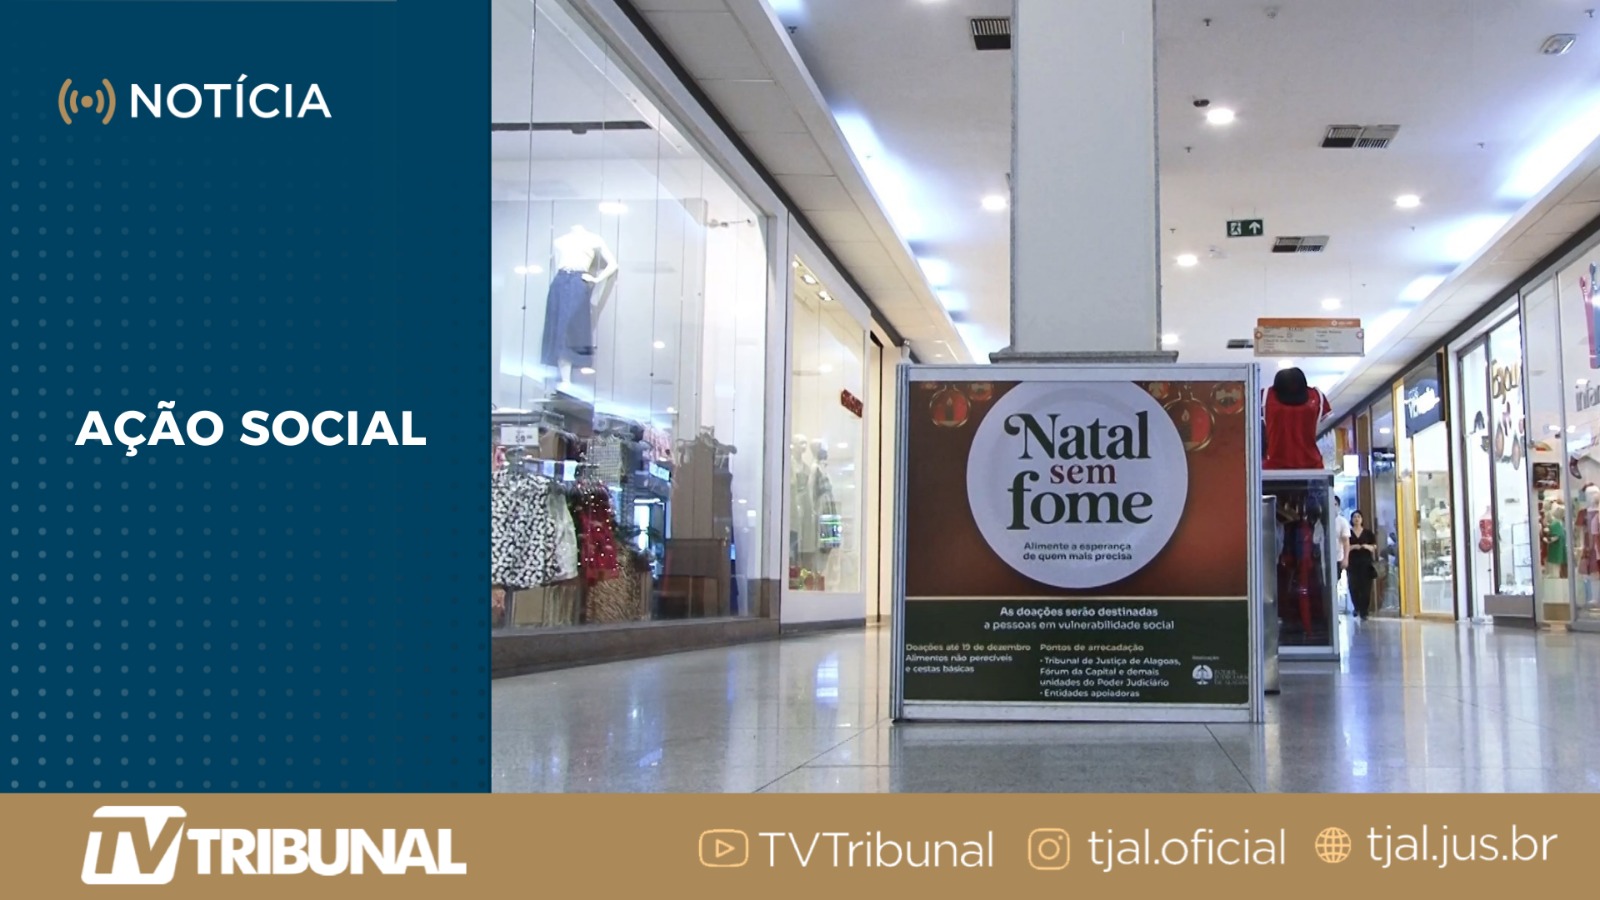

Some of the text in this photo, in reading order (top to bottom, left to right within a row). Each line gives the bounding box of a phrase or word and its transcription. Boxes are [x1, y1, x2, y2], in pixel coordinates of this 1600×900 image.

[1004, 410, 1152, 460] Natal
[1050, 463, 1117, 485] sem
[1006, 470, 1153, 531] fome
[1023, 541, 1132, 553] Alimente a esperança
[1022, 551, 1133, 562] de quem mais precisa
[1000, 606, 1159, 619] As doações serão destinadas
[983, 620, 1175, 631] a pessoas em vulnerabilidade social
[905, 643, 944, 653] Doações
[945, 643, 960, 651] até
[972, 643, 985, 651] de
[986, 643, 1032, 652] dezembro
[1039, 643, 1145, 654] Pontos de arrecadação
[905, 653, 1013, 663] Alimentos não perecíveis
[1044, 656, 1181, 667] Tribunal de Justiça de Alagoas,
[912, 665, 941, 673] cestas
[942, 664, 975, 673] básicas
[1039, 667, 1070, 676] Fórum
[1071, 667, 1083, 676] da
[1084, 667, 1117, 677] Capital
[1126, 667, 1160, 676] demais
[1039, 678, 1170, 687] unidades do Poder Judiciário
[1043, 688, 1140, 698] Entidades apoiadoras
